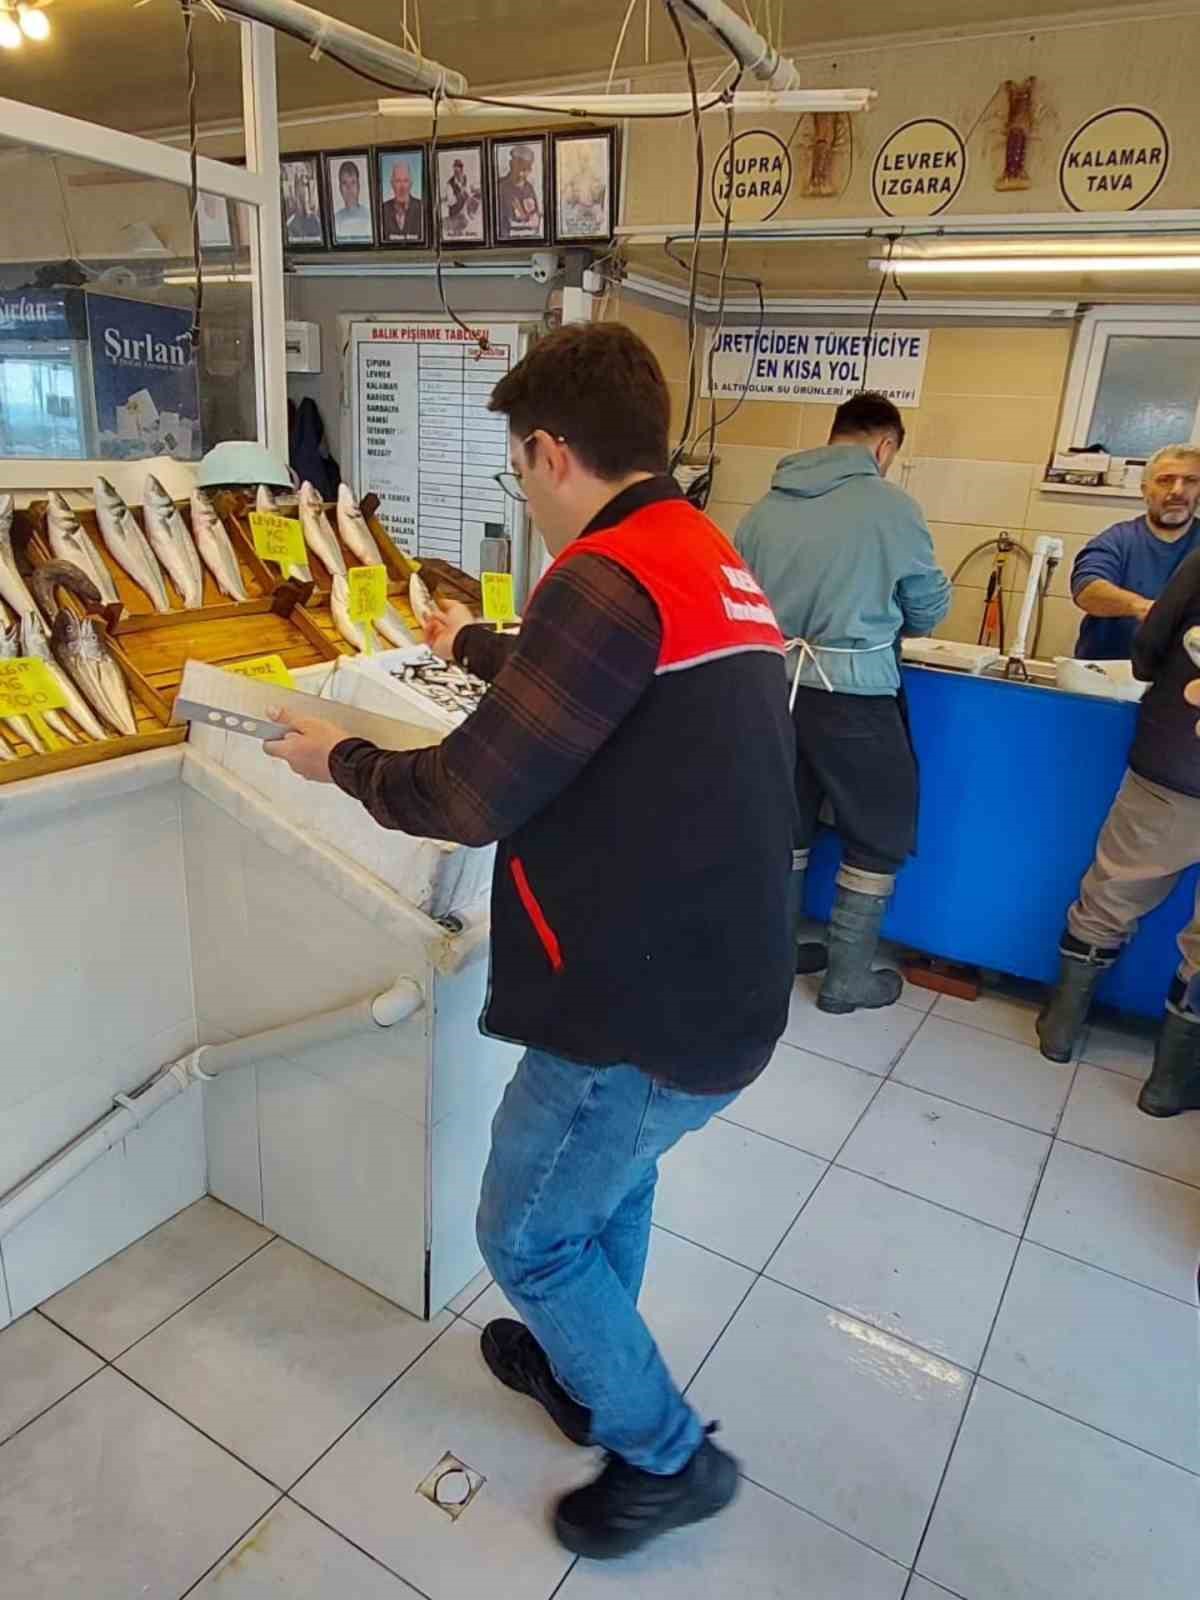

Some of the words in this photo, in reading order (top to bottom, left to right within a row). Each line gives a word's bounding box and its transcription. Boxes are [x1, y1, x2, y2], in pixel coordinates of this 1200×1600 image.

[882, 151, 957, 171] LEVREK
[1068, 148, 1162, 168] KALAMAR
[1087, 174, 1133, 192] TAVA
[372, 328, 400, 339] BALIK
[401, 325, 441, 341] PİŞİRME
[815, 331, 920, 357] TÜKETİCİYE
[756, 359, 777, 378] EN
[783, 360, 821, 380] KISA
[829, 361, 860, 381] YOL
[777, 385, 790, 394] SU
